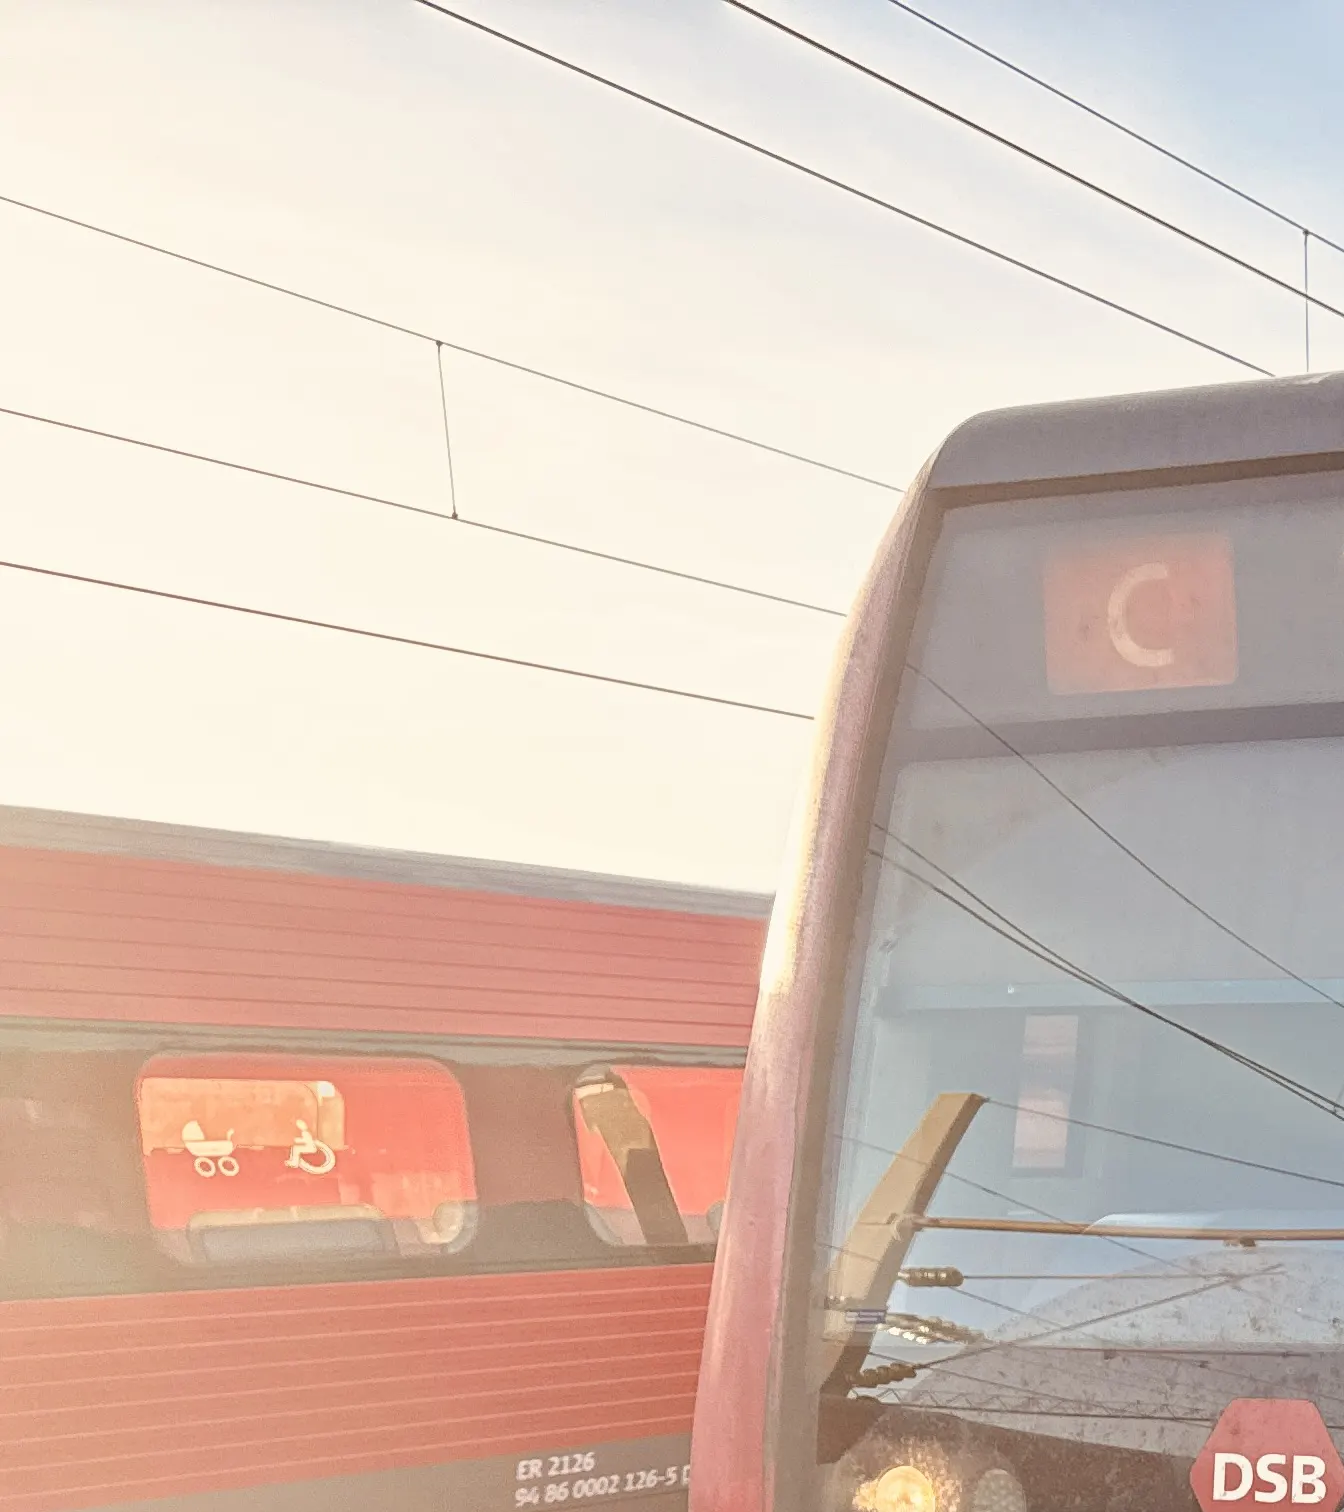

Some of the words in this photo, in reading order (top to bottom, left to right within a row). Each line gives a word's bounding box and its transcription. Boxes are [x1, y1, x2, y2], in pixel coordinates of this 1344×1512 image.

[1105, 561, 1174, 669] C
[515, 1486, 540, 1508] 94
[544, 1481, 569, 1503] 86
[572, 1474, 621, 1499] 0002
[623, 1465, 678, 1492] 126-5
[516, 1458, 543, 1480] ER
[547, 1452, 596, 1477] 2126
[1211, 1452, 1327, 1504] DSB
